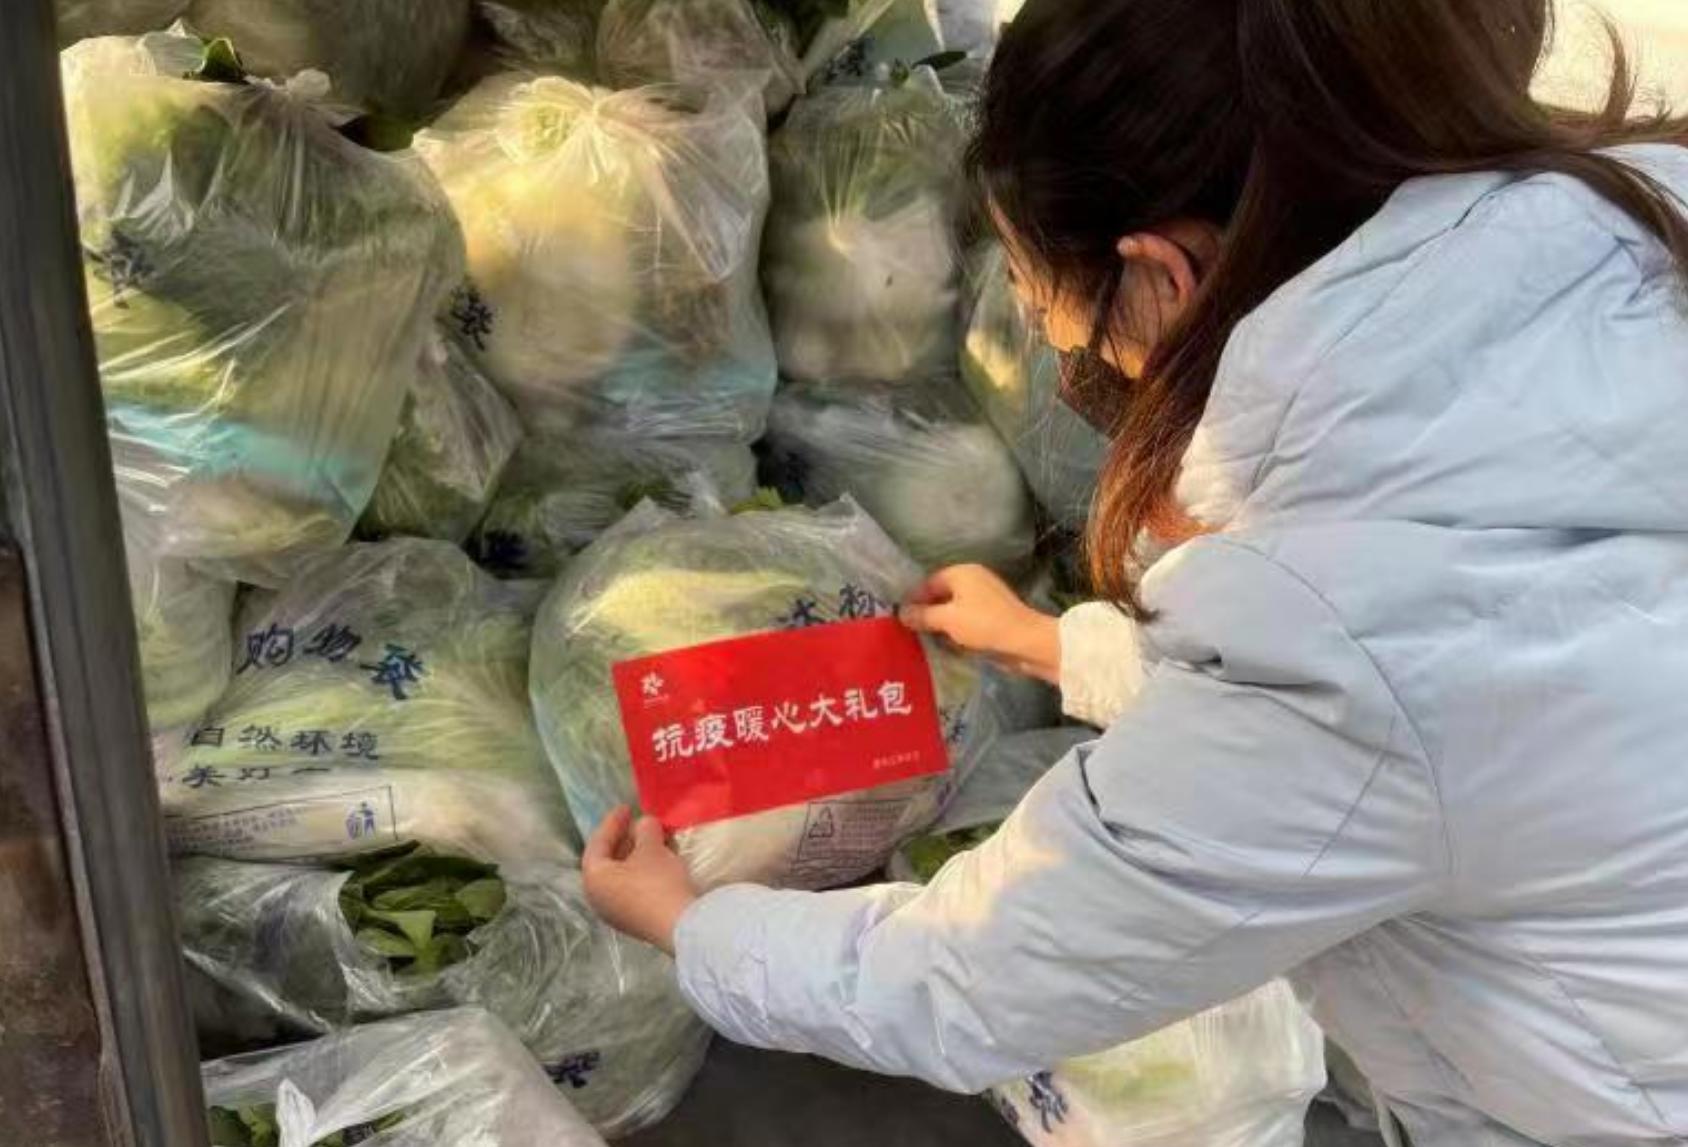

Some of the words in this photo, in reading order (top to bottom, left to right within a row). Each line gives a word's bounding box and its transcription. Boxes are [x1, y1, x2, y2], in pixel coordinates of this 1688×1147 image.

[651, 679, 913, 763] 抗疫暖心大礼包
